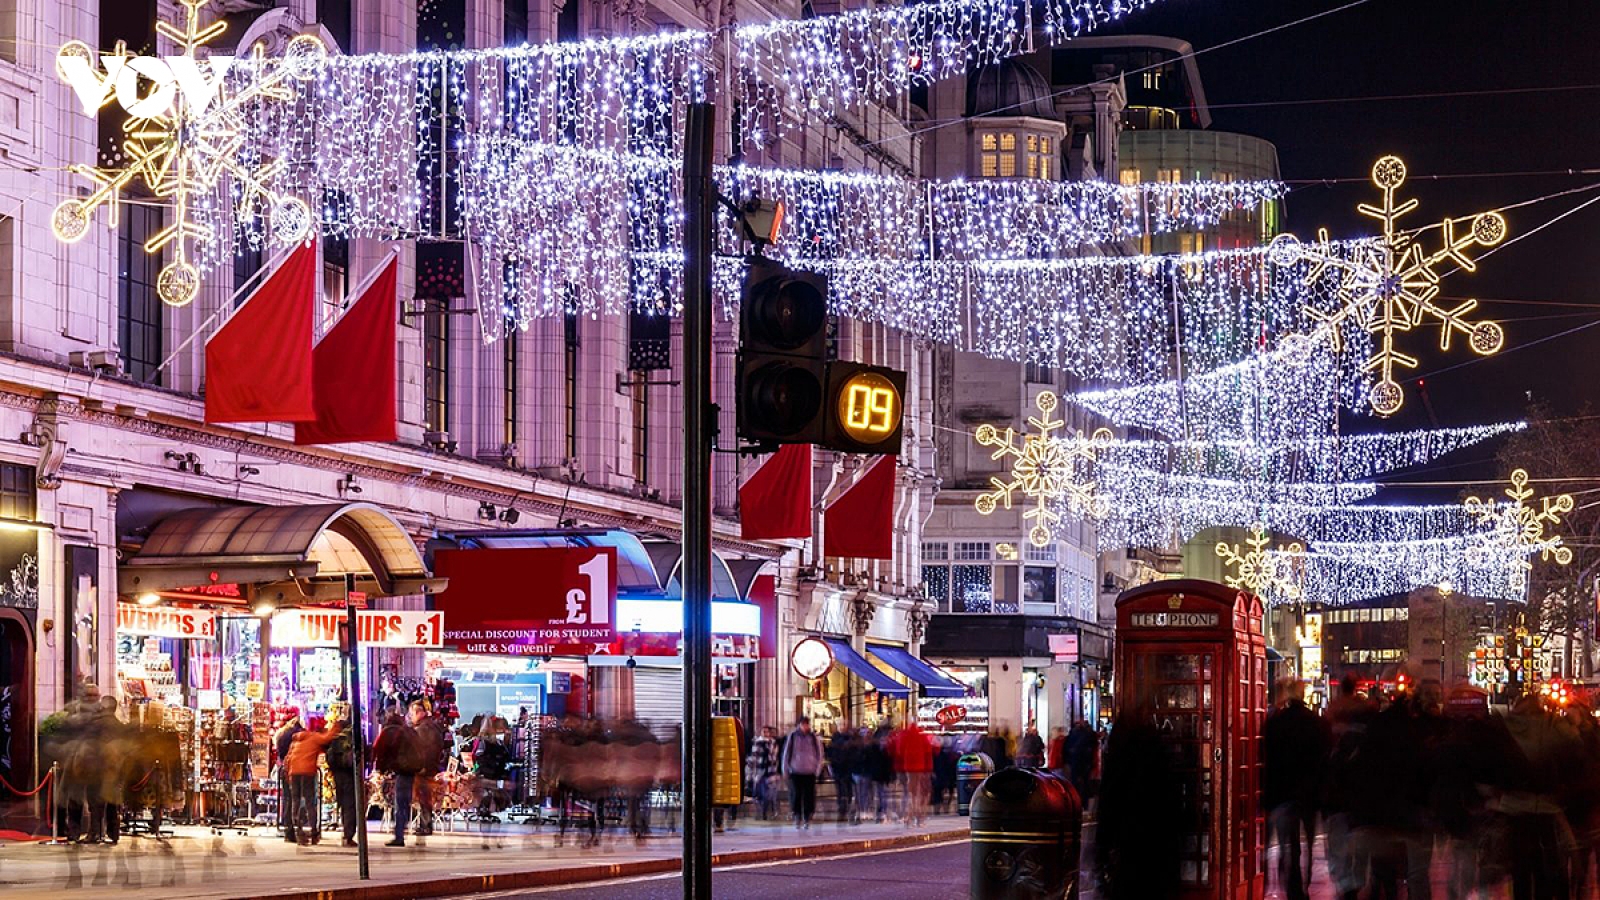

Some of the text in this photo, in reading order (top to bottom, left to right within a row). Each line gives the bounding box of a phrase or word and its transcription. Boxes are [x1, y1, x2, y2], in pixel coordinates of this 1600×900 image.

[848, 385, 893, 432] 09
[566, 553, 609, 624] £1
[416, 613, 441, 645] £1
[443, 628, 610, 640] SPECIAL DISCOUNT FOR STUDENT
[500, 643, 555, 654] Souvenir
[937, 707, 966, 723] SALE
